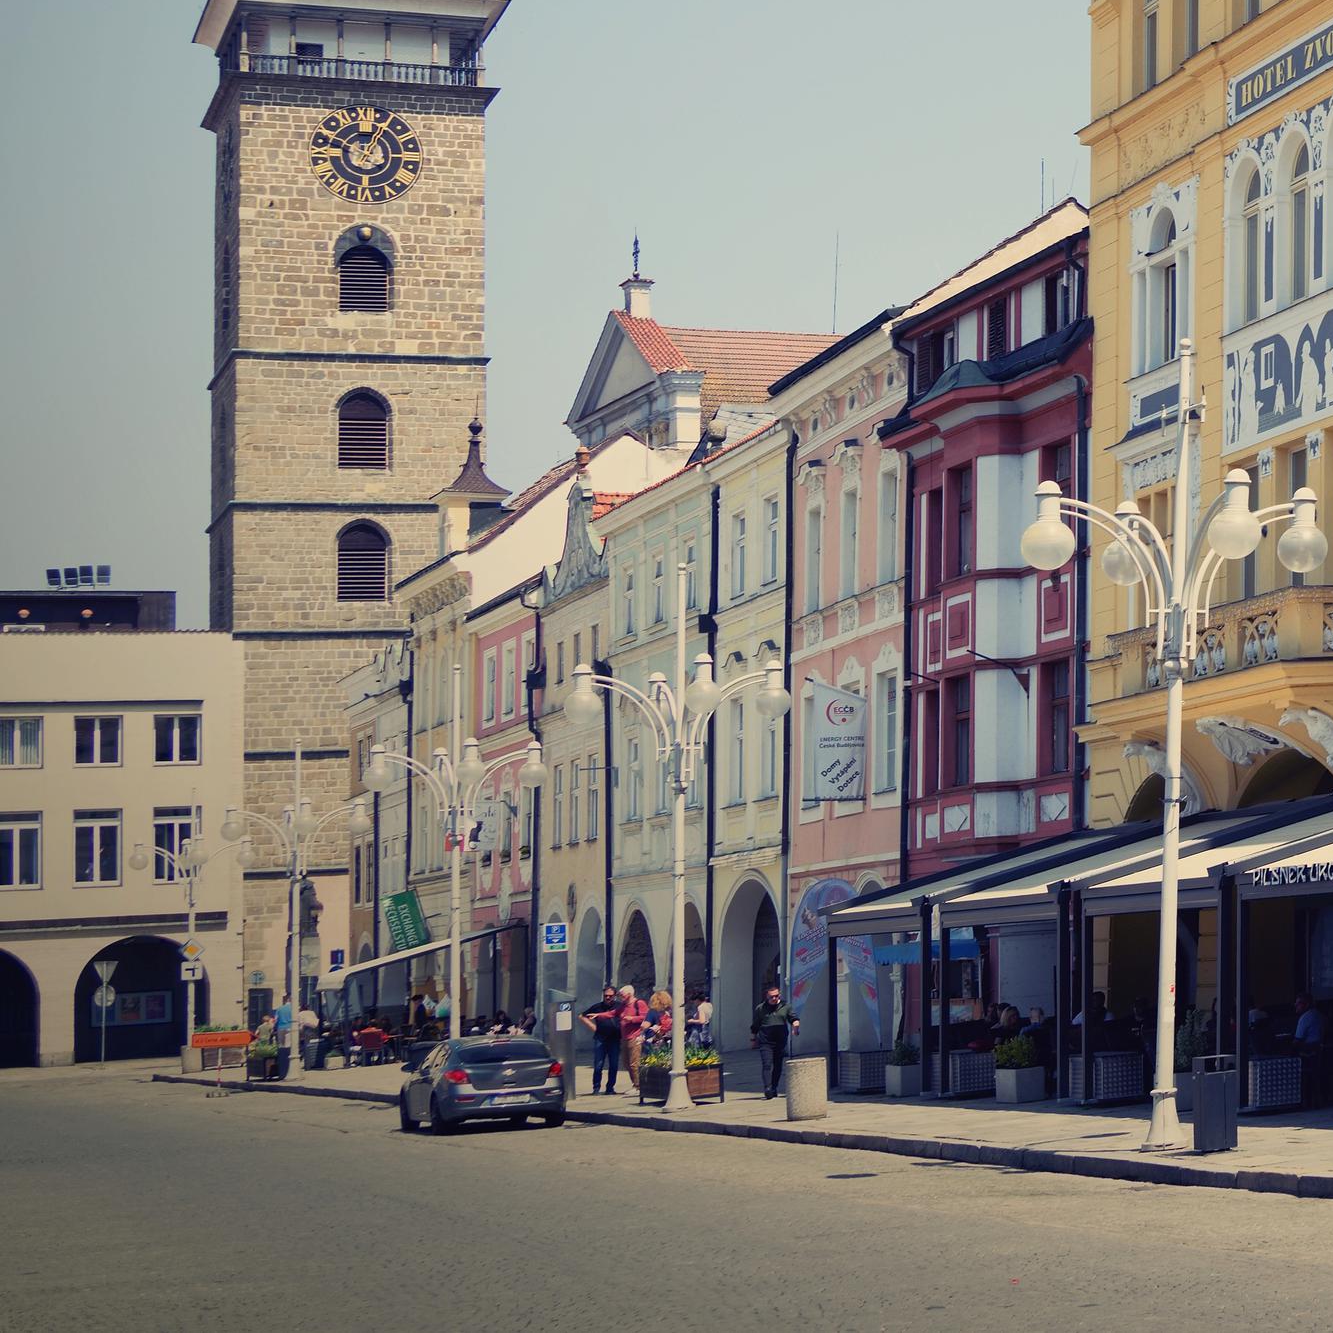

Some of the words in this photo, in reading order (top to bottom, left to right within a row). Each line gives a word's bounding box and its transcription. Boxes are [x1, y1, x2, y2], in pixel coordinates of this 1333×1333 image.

[1241, 55, 1296, 107] HOTEL
[821, 758, 841, 777] Domy
[837, 770, 860, 792] Dotace
[1252, 864, 1307, 886] PILSNER
[398, 903, 420, 947] EXCHANGE
